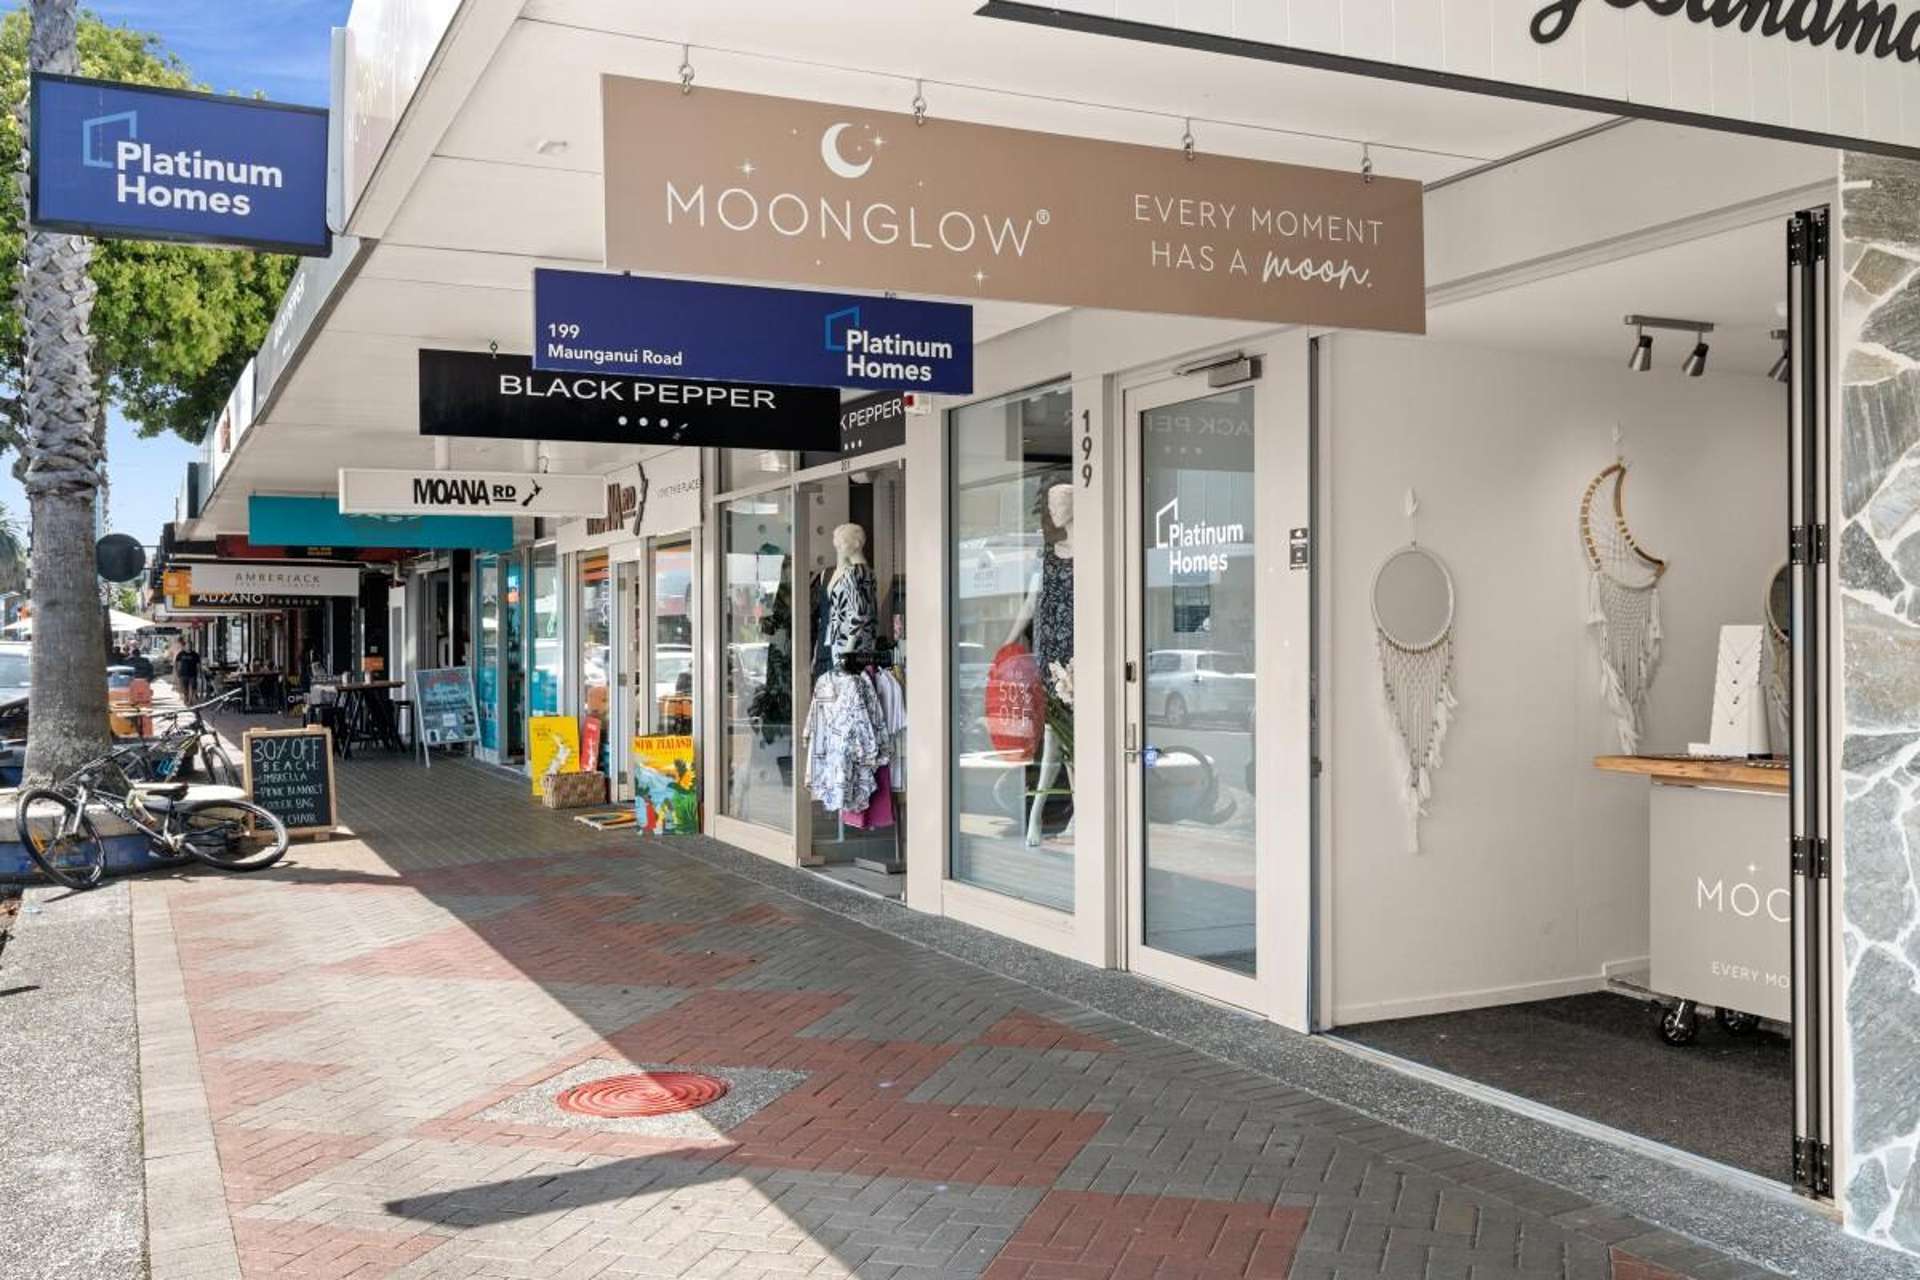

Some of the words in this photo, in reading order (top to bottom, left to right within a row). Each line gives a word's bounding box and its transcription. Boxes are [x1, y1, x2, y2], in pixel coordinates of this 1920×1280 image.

[116, 140, 283, 188] Platinum
[116, 173, 251, 216] Homes
[1134, 193, 1236, 229] EVERY
[1250, 207, 1383, 245] MOMENT
[1151, 240, 1214, 272] HAS
[1229, 251, 1248, 275] A
[548, 323, 580, 339] 199
[846, 329, 953, 360] Platinum
[547, 343, 639, 365] Maunganui
[642, 350, 683, 366] Road
[846, 353, 932, 382] Homes
[499, 374, 624, 401] BLACK
[633, 382, 778, 409] PEPPER
[848, 398, 902, 430] PEPPER
[1081, 409, 1093, 488] 199
[413, 477, 491, 506] MOANA
[492, 484, 516, 502] RD
[1168, 522, 1244, 547] Platinum
[1168, 551, 1229, 575] Homes
[1712, 961, 1759, 981] EVERY
